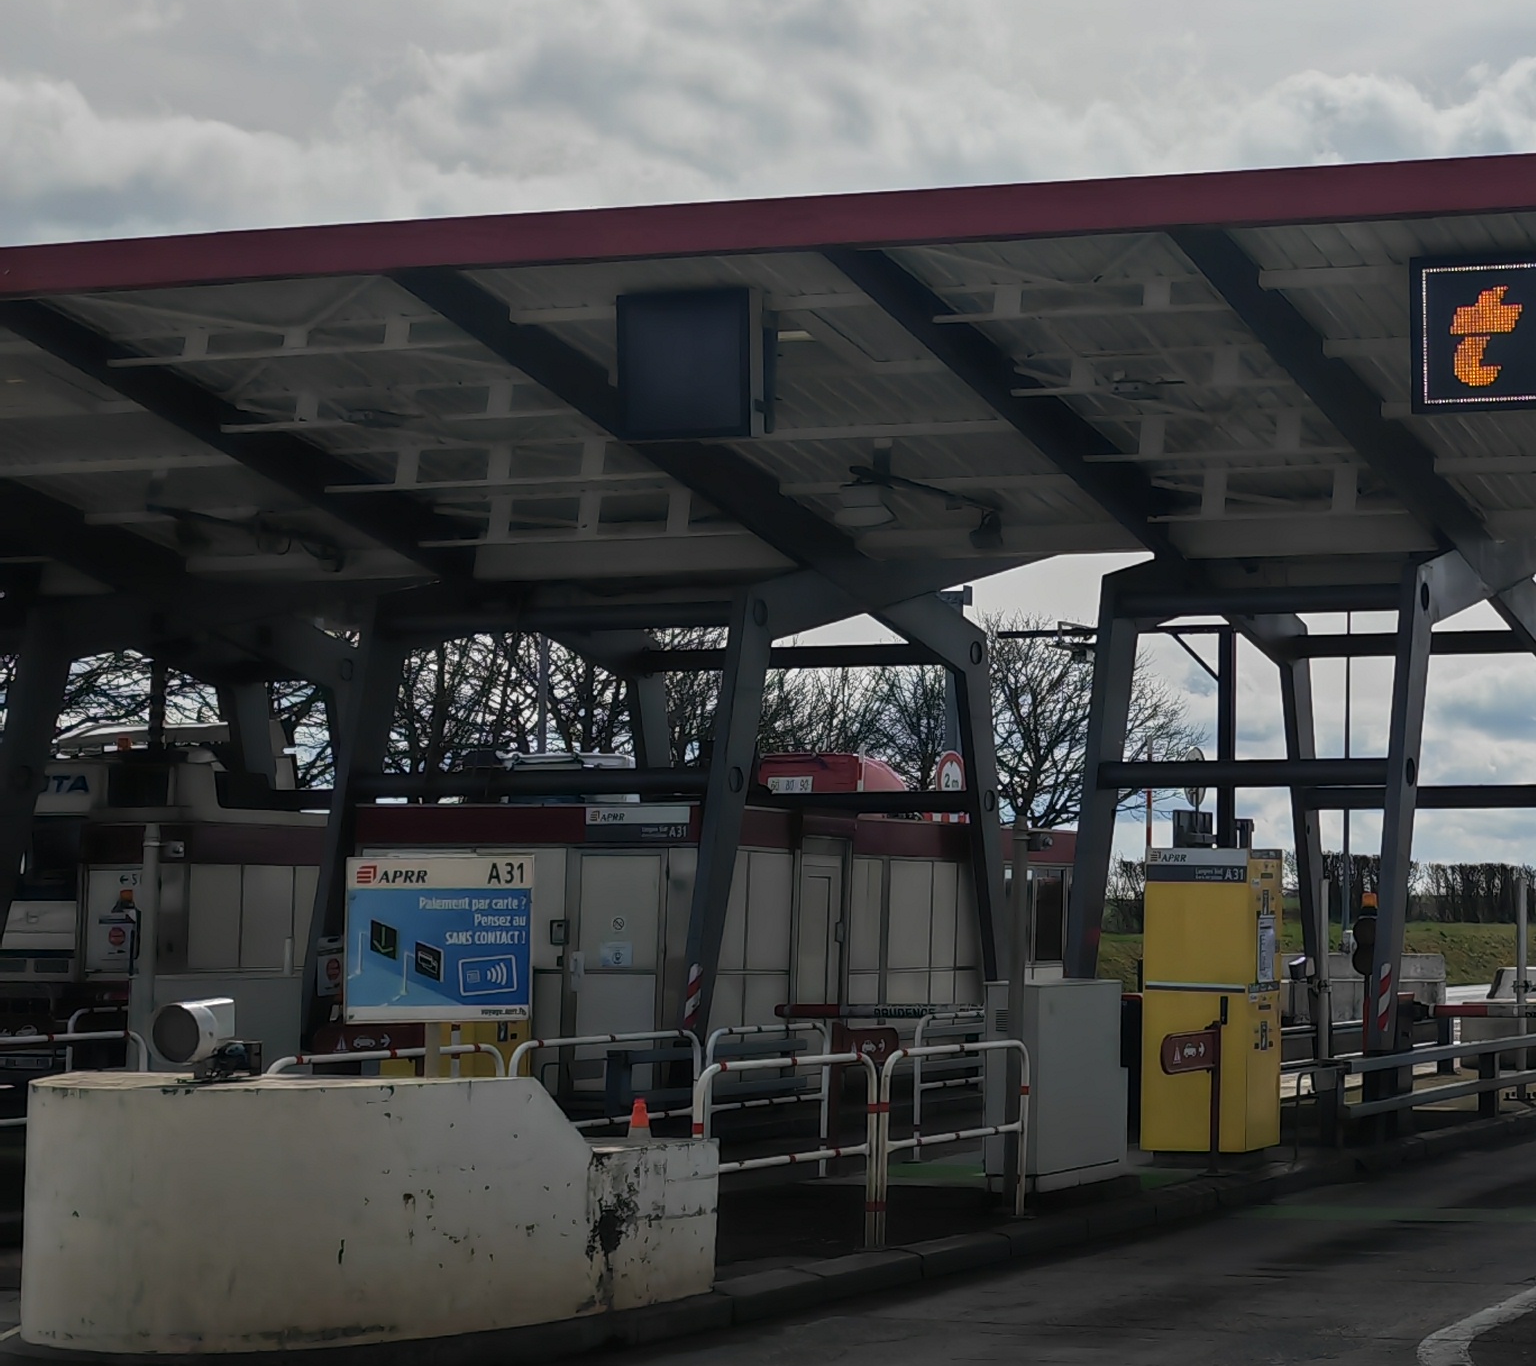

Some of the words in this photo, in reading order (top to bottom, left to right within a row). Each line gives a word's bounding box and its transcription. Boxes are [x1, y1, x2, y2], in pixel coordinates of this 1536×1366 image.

[44, 775, 89, 793] TA
[944, 773, 951, 788] 2
[951, 779, 959, 788] m
[1161, 853, 1188, 863] APRR
[378, 869, 428, 884] APRR
[1224, 868, 1244, 881] A31
[419, 896, 470, 910] Paiement
[472, 898, 490, 911] par
[491, 897, 519, 910] carte
[520, 896, 527, 910] ?
[474, 913, 511, 927] Pensez
[513, 916, 527, 927] au
[445, 930, 473, 945] SANS
[474, 930, 520, 945] CONTACT
